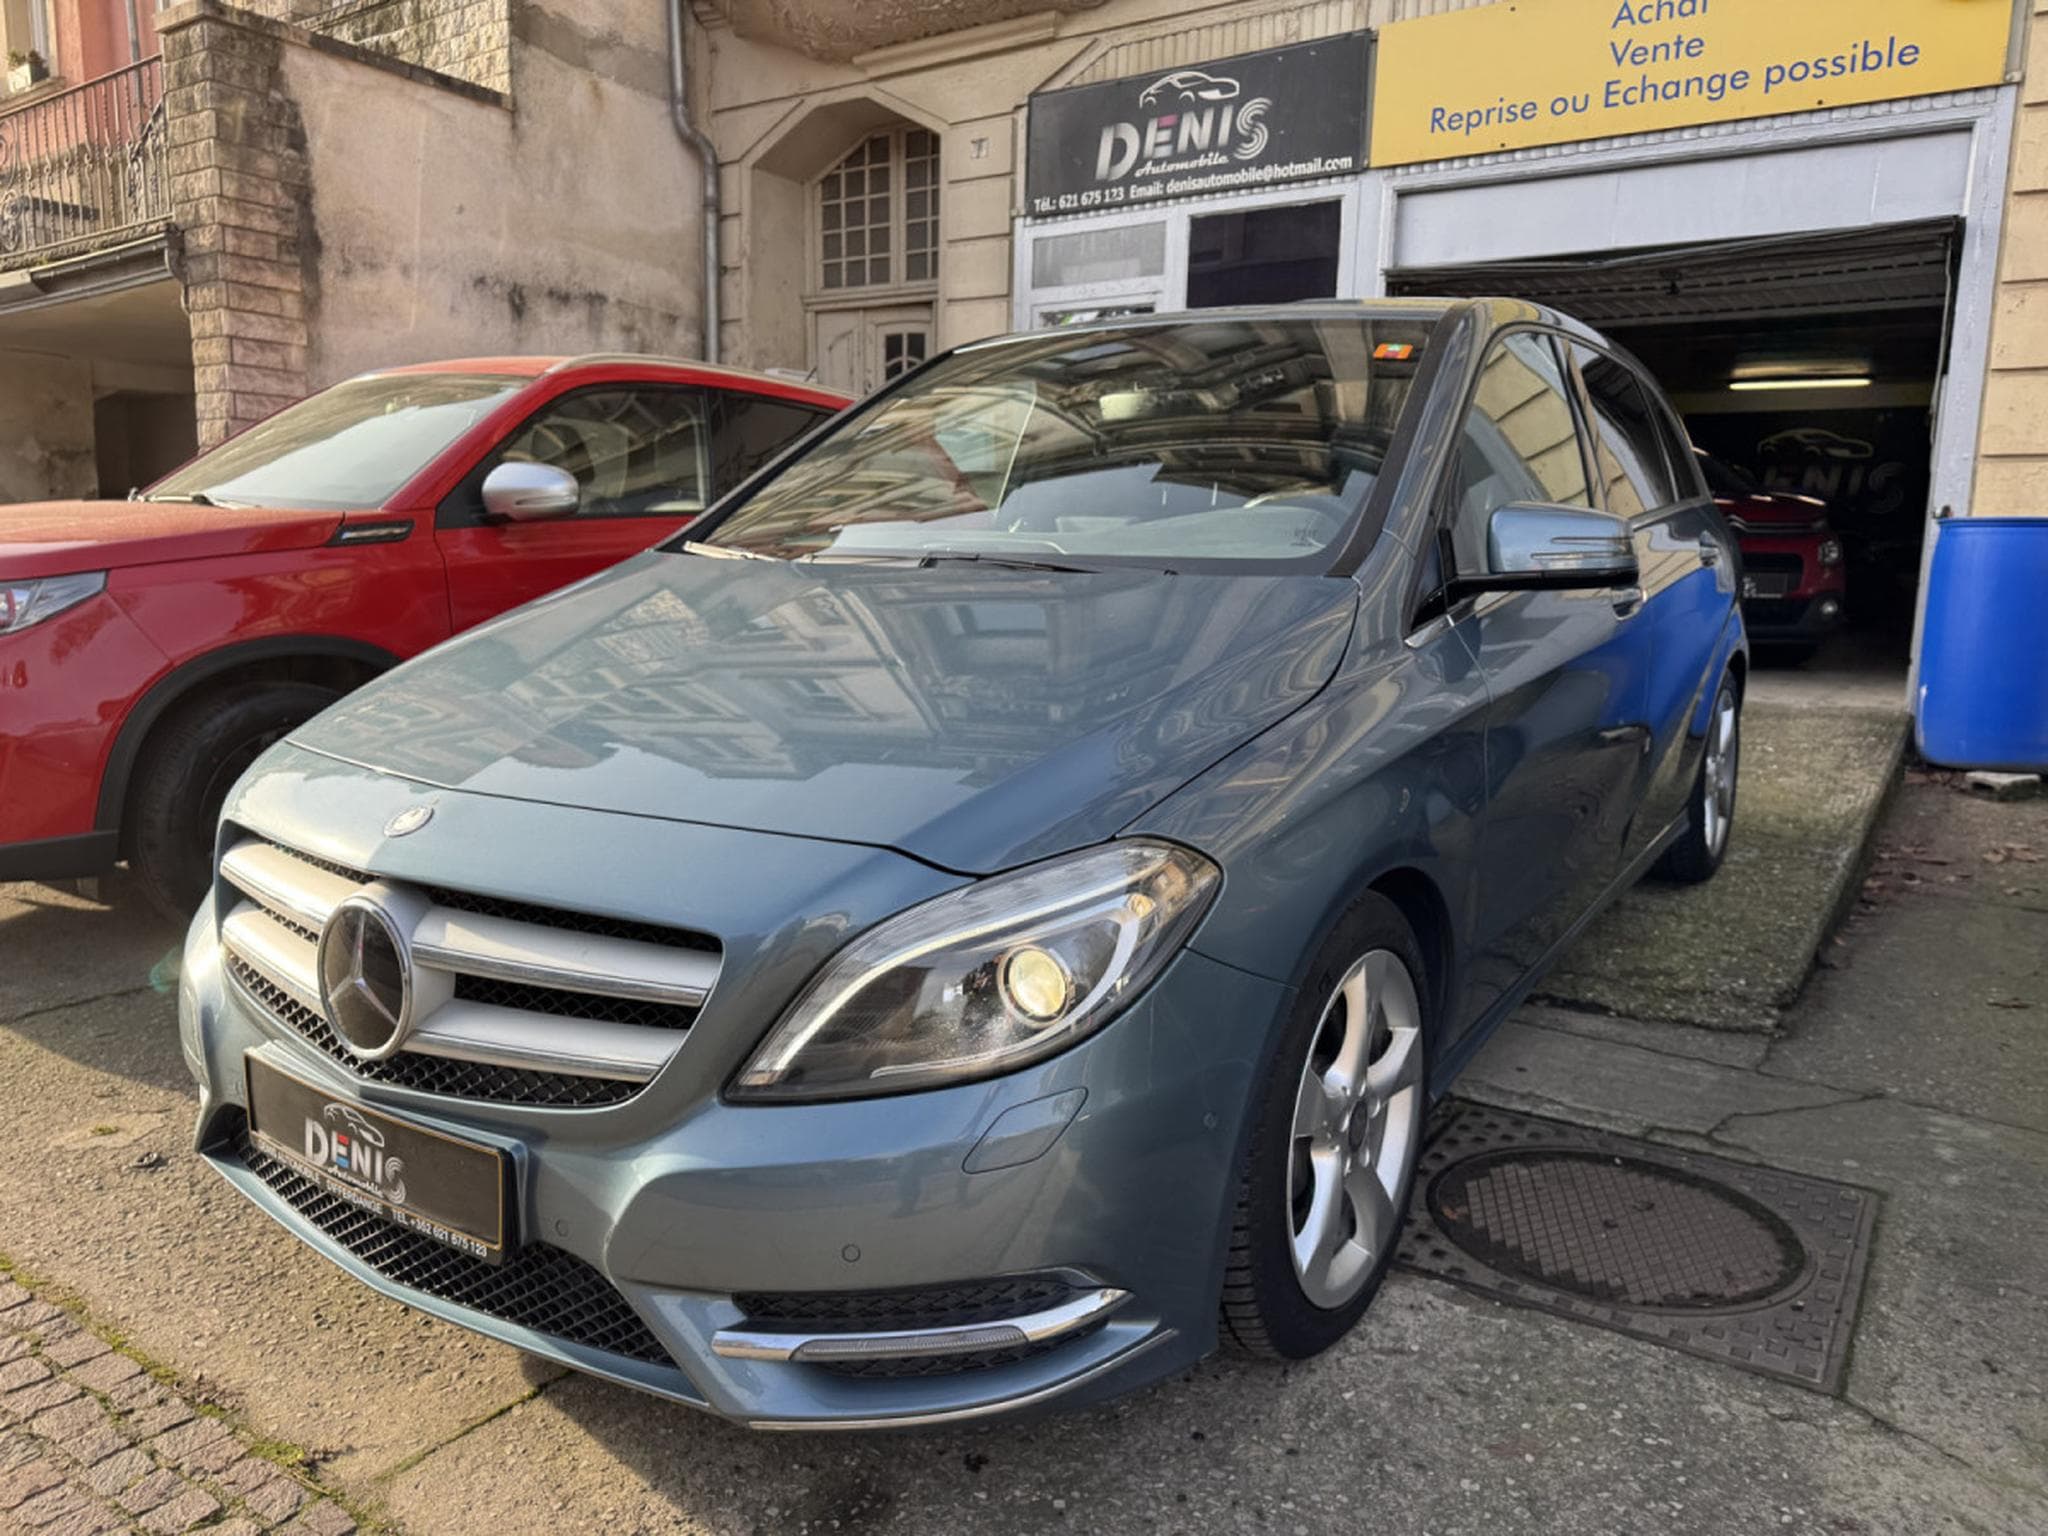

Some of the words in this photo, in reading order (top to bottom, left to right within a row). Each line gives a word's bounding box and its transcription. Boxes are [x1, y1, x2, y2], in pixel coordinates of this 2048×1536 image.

[1610, 35, 1704, 66] Vente
[1430, 97, 1538, 136] Reprise
[1550, 93, 1590, 116] ou
[1603, 70, 1750, 108] Echange
[1764, 36, 1920, 94] possible
[1095, 97, 1273, 182] DENIS
[1134, 152, 1229, 177] Automobile
[1058, 193, 1080, 209] 621
[1081, 190, 1101, 206] 675
[1129, 181, 1164, 198] Email:
[1166, 156, 1353, 194] denisautomobile@hotmail.com
[305, 1117, 407, 1204] DENIS
[470, 1241, 488, 1257] 123
